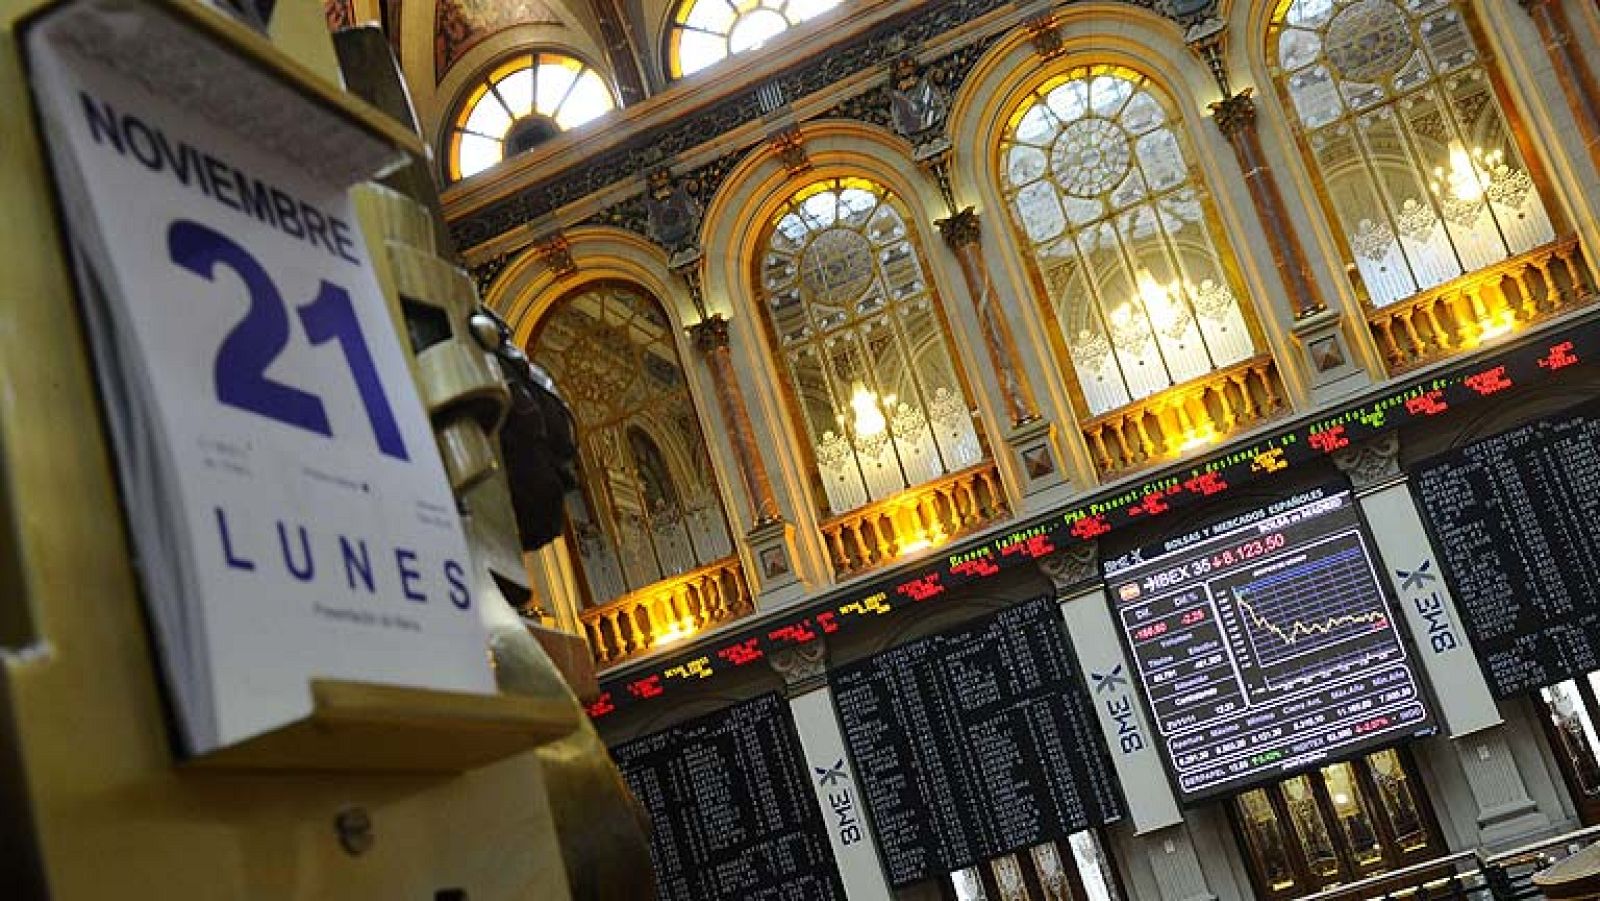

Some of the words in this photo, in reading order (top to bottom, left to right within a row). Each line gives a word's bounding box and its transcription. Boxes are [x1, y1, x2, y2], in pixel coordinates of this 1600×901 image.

[78, 92, 361, 267] NOVIEMBRE
[166, 217, 410, 463] 21
[1164, 531, 1201, 551] BOLSAS
[1202, 526, 1209, 537] Y
[1212, 508, 1266, 534] MERCADOS
[1268, 487, 1324, 514] ESPAÑOLES
[215, 506, 471, 611] LUNES
[1191, 558, 1211, 576] 35
[1222, 534, 1284, 566] 8.123,50
[1415, 592, 1456, 654] BME
[1105, 698, 1145, 755] BME
[828, 789, 862, 846] BME
